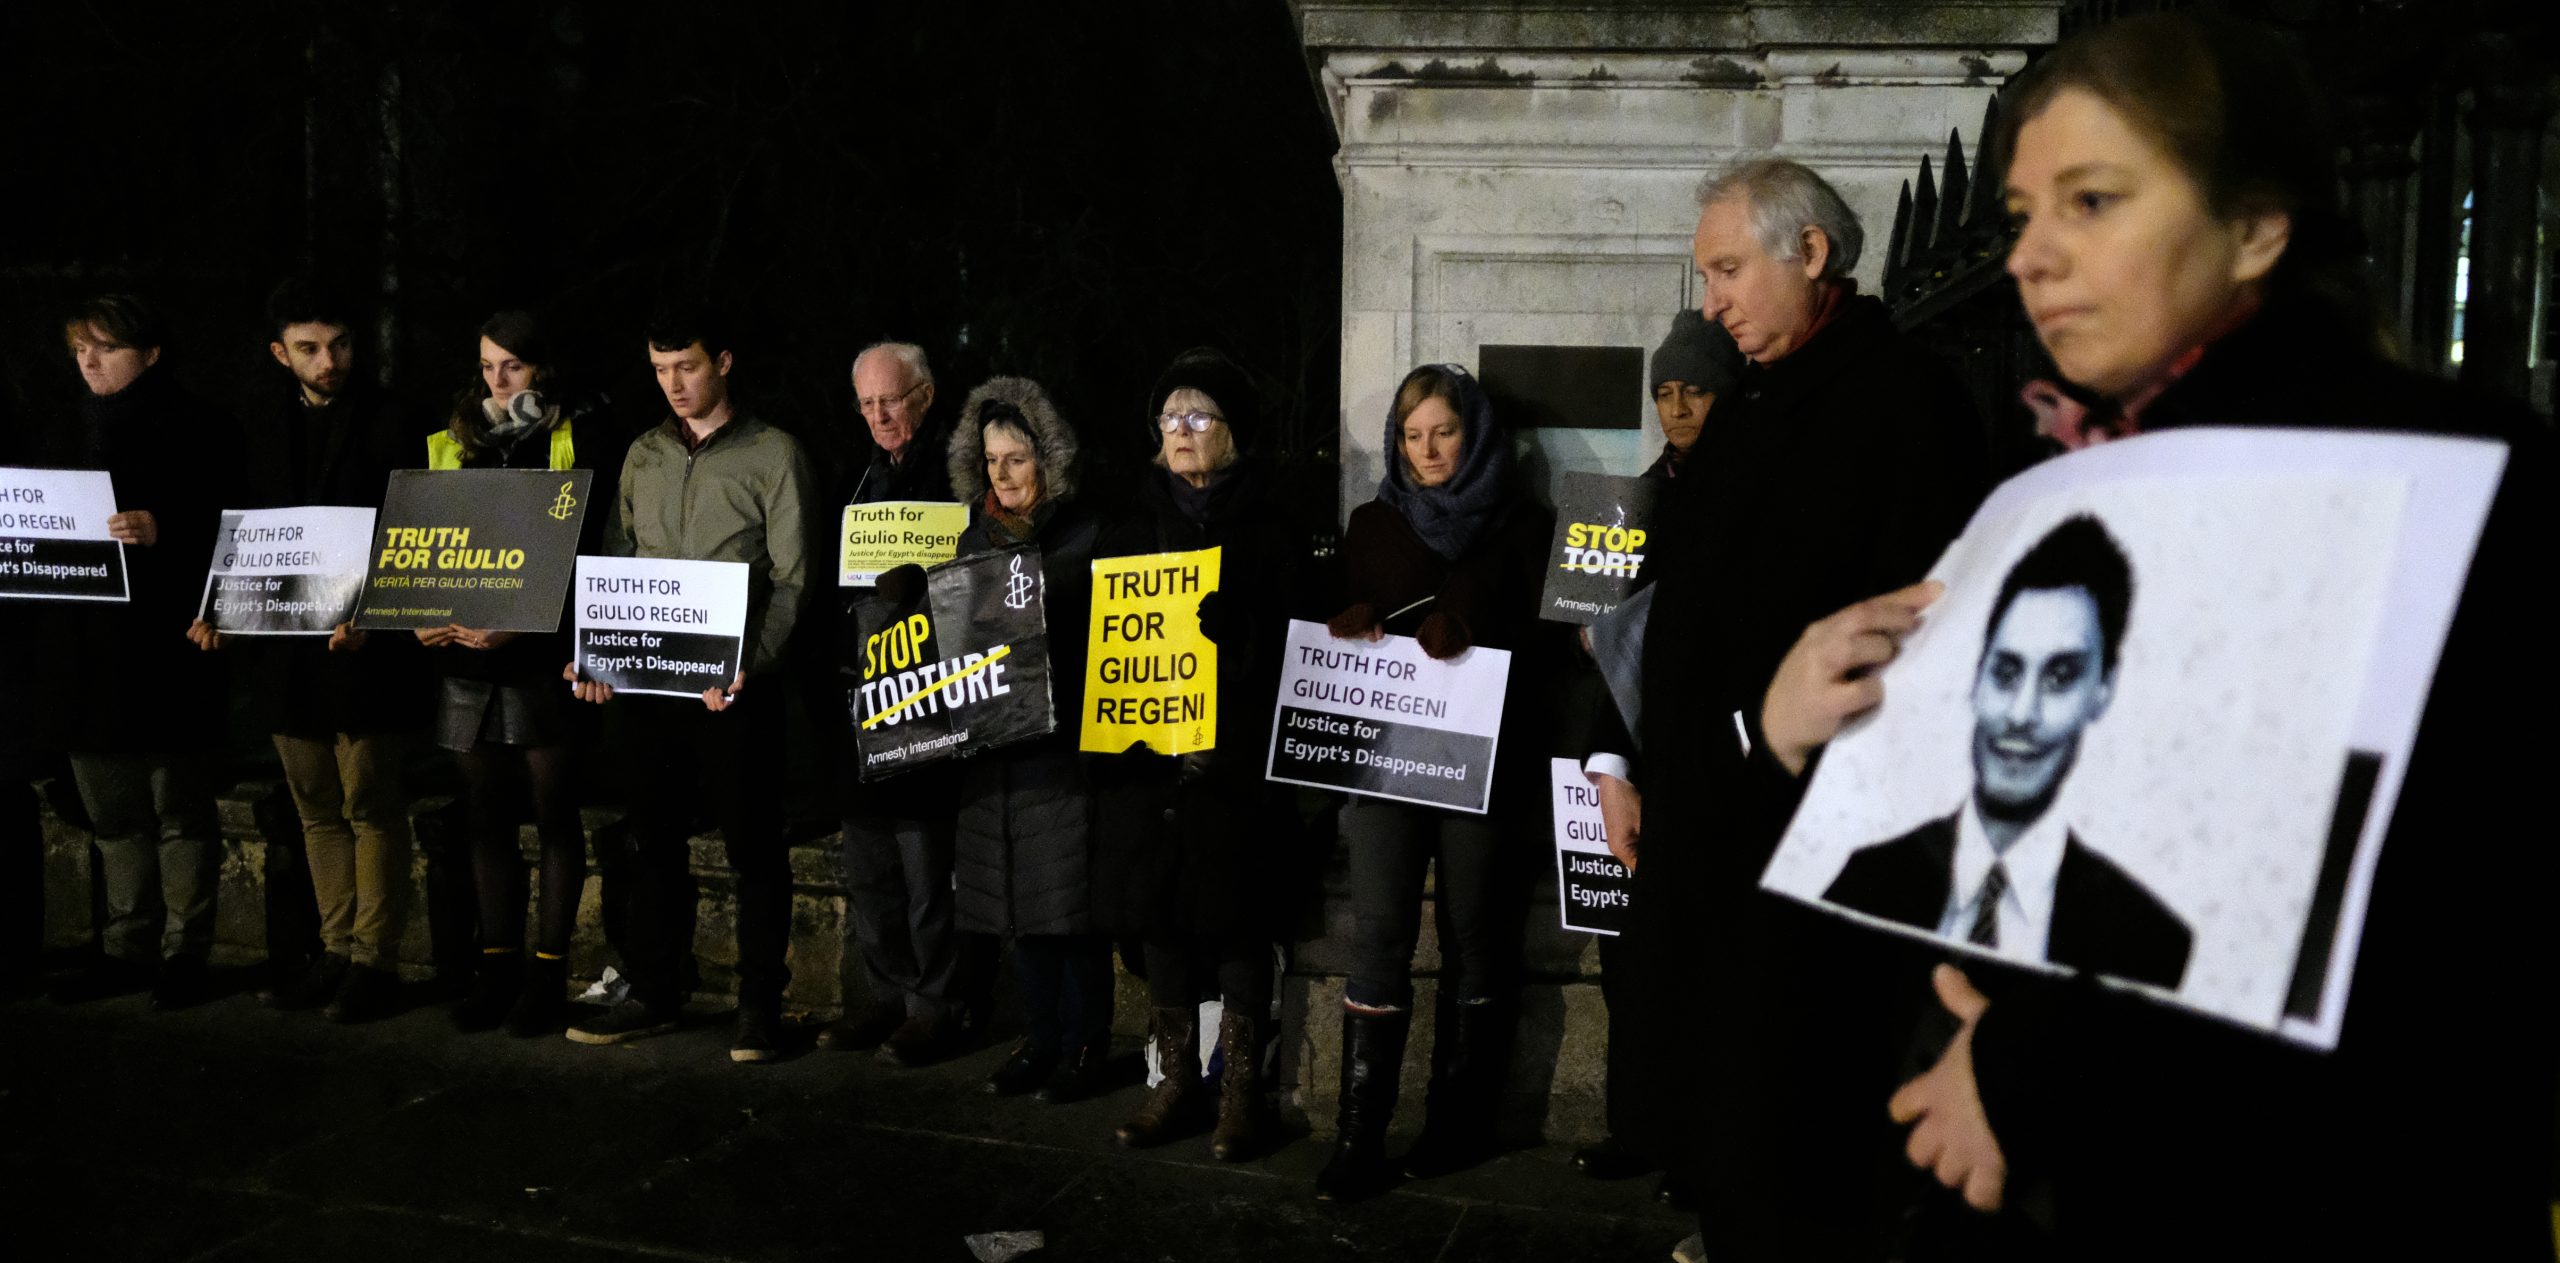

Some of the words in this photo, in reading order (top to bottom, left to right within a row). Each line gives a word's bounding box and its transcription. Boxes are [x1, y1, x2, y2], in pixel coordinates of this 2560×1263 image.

[13, 488, 45, 503] FOR
[18, 514, 76, 530] REGENI
[851, 508, 895, 522] Truth
[900, 507, 924, 522] for
[229, 528, 275, 543] TRUTH
[278, 526, 303, 540] FOR
[386, 528, 470, 547] TRUTH
[849, 530, 898, 545] Giulio
[1566, 522, 1647, 553] STOP
[15, 540, 35, 553] for
[848, 549, 874, 558] Justice
[874, 550, 886, 558] for
[888, 550, 915, 559] Egypt's
[223, 553, 273, 567] GIULIO
[276, 551, 321, 566] REGEN
[378, 549, 431, 569] FOR
[437, 549, 525, 569] GIULIO
[1563, 546, 1645, 579] TORT
[22, 561, 108, 579] Disappeared
[217, 578, 263, 591] Justice
[265, 578, 282, 591] for
[373, 575, 410, 588] VERITÀ
[413, 577, 435, 588] PER
[438, 577, 478, 588] GIULIO
[480, 577, 523, 589] REGENI
[586, 577, 644, 594] TRUTH
[649, 579, 681, 595] FOR
[1104, 565, 1200, 600] TRUTH
[214, 599, 263, 615] Egypt's
[266, 599, 344, 615] Disappead
[364, 607, 399, 618] Amnesty
[401, 607, 452, 616] International
[587, 604, 645, 620] GIULIO
[651, 606, 708, 624] REGENI
[1554, 596, 1602, 615] Amnesty
[1102, 611, 1165, 643] FOR
[587, 632, 638, 647] Justice
[642, 632, 662, 647] for
[863, 613, 930, 680] STOP
[587, 654, 643, 672] Egypt's
[646, 656, 724, 675] Disappeared
[1099, 652, 1198, 684] GIULIO
[1299, 646, 1370, 674] TRUTH
[1374, 658, 1417, 681] FOR
[861, 644, 1011, 731] TORTURE
[1293, 678, 1365, 706] GIULIO
[1370, 690, 1448, 718] REGENI
[1096, 692, 1205, 725] REGENI
[1287, 711, 1349, 735] Justice
[1353, 720, 1381, 740] for
[867, 748, 907, 766] Amnesty
[909, 728, 969, 754] International
[1284, 737, 1350, 763] Egypt's
[1355, 748, 1467, 781] Disappeared
[1564, 785, 1600, 808] TRU
[1567, 820, 1608, 843] GIUL
[1569, 855, 1623, 878] Justice
[1570, 884, 1630, 908] Egypt's
